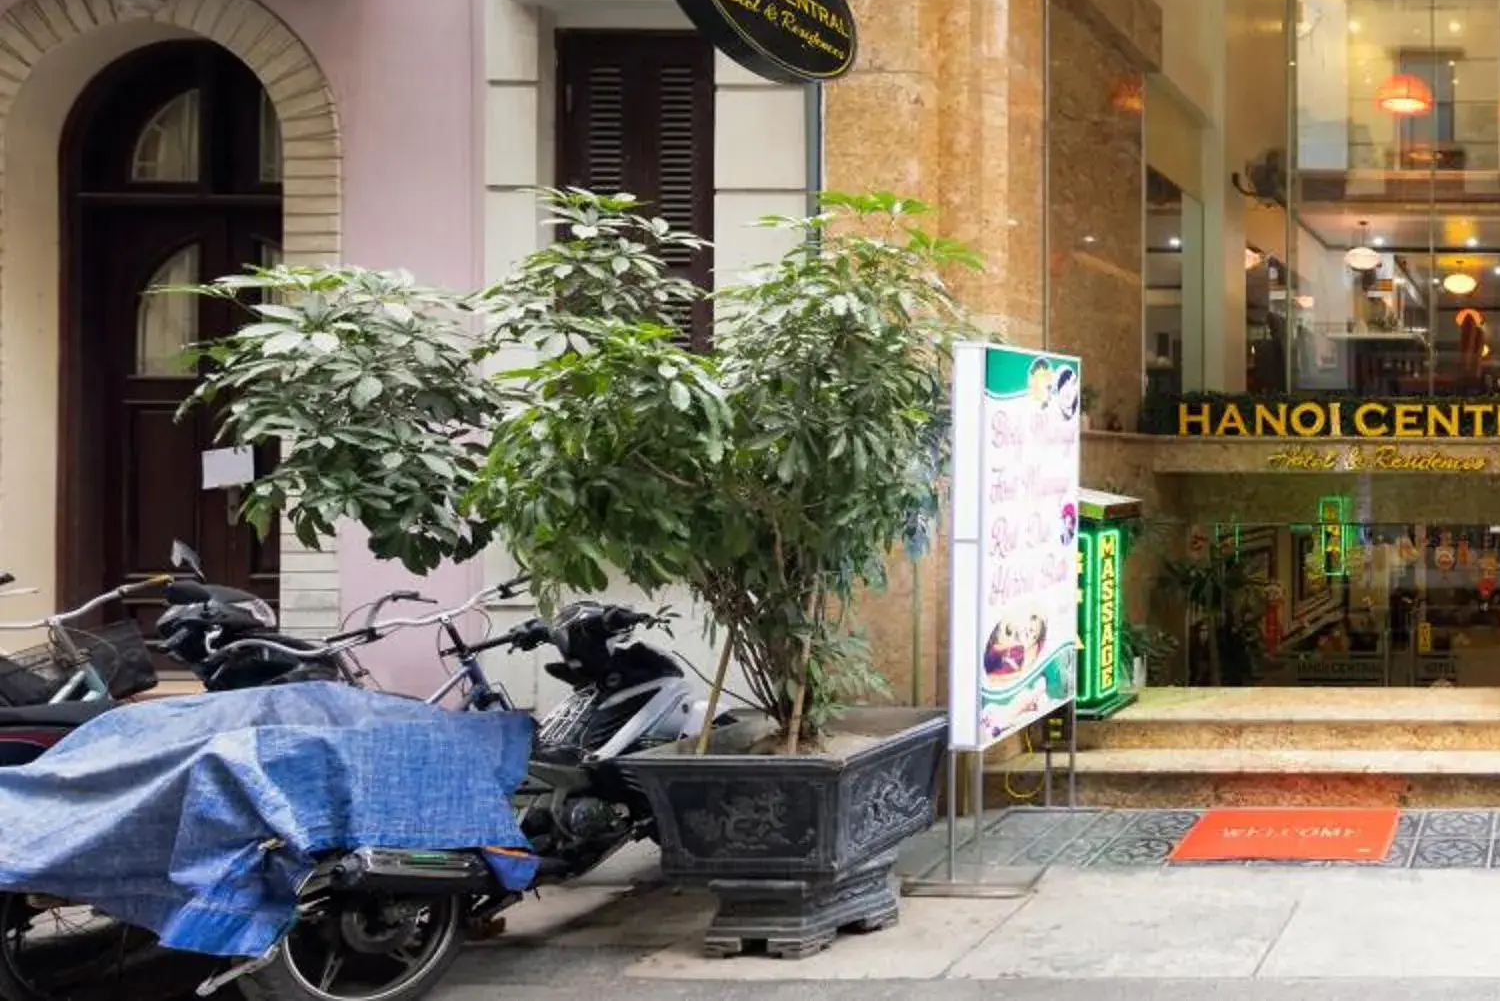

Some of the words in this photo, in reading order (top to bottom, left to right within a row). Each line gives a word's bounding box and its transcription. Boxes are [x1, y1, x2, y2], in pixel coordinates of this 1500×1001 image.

[762, 4, 779, 22] &
[1178, 402, 1341, 437] HANOI
[1268, 449, 1336, 470] Hotel
[1341, 445, 1364, 471] &
[1373, 445, 1487, 472] Residences
[1098, 533, 1117, 688] MASSAGE
